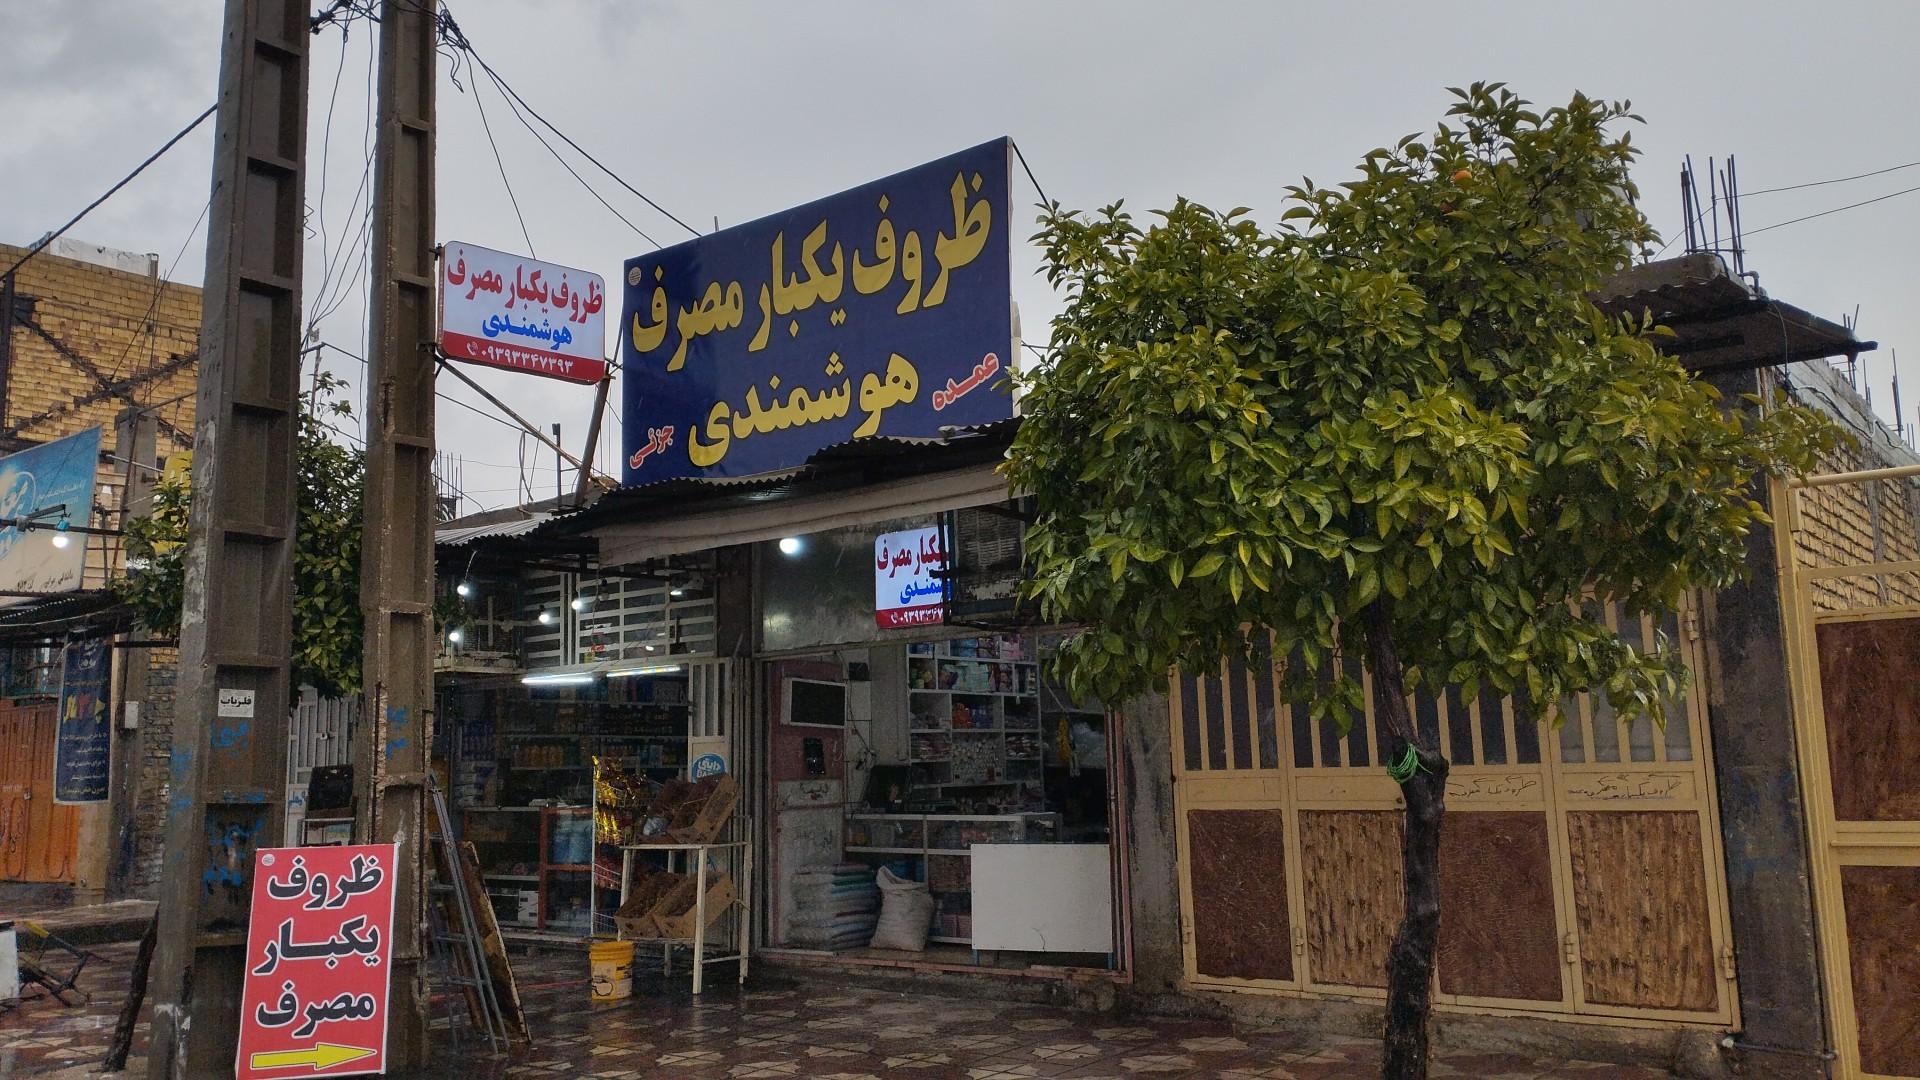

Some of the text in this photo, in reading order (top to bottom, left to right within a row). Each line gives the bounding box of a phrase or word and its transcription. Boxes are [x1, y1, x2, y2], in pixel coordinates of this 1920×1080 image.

[447, 249, 602, 324] ظروف یکبار مصرف
[632, 171, 992, 372] ظروف یکبار مصرف
[482, 313, 573, 350] هوشمندی
[688, 351, 920, 467] هوشمندی
[932, 352, 1000, 412] عمده
[876, 538, 912, 579] مصرف
[267, 854, 384, 910] ظروف
[252, 915, 381, 976] یکبار
[255, 980, 376, 1038] مصرف
